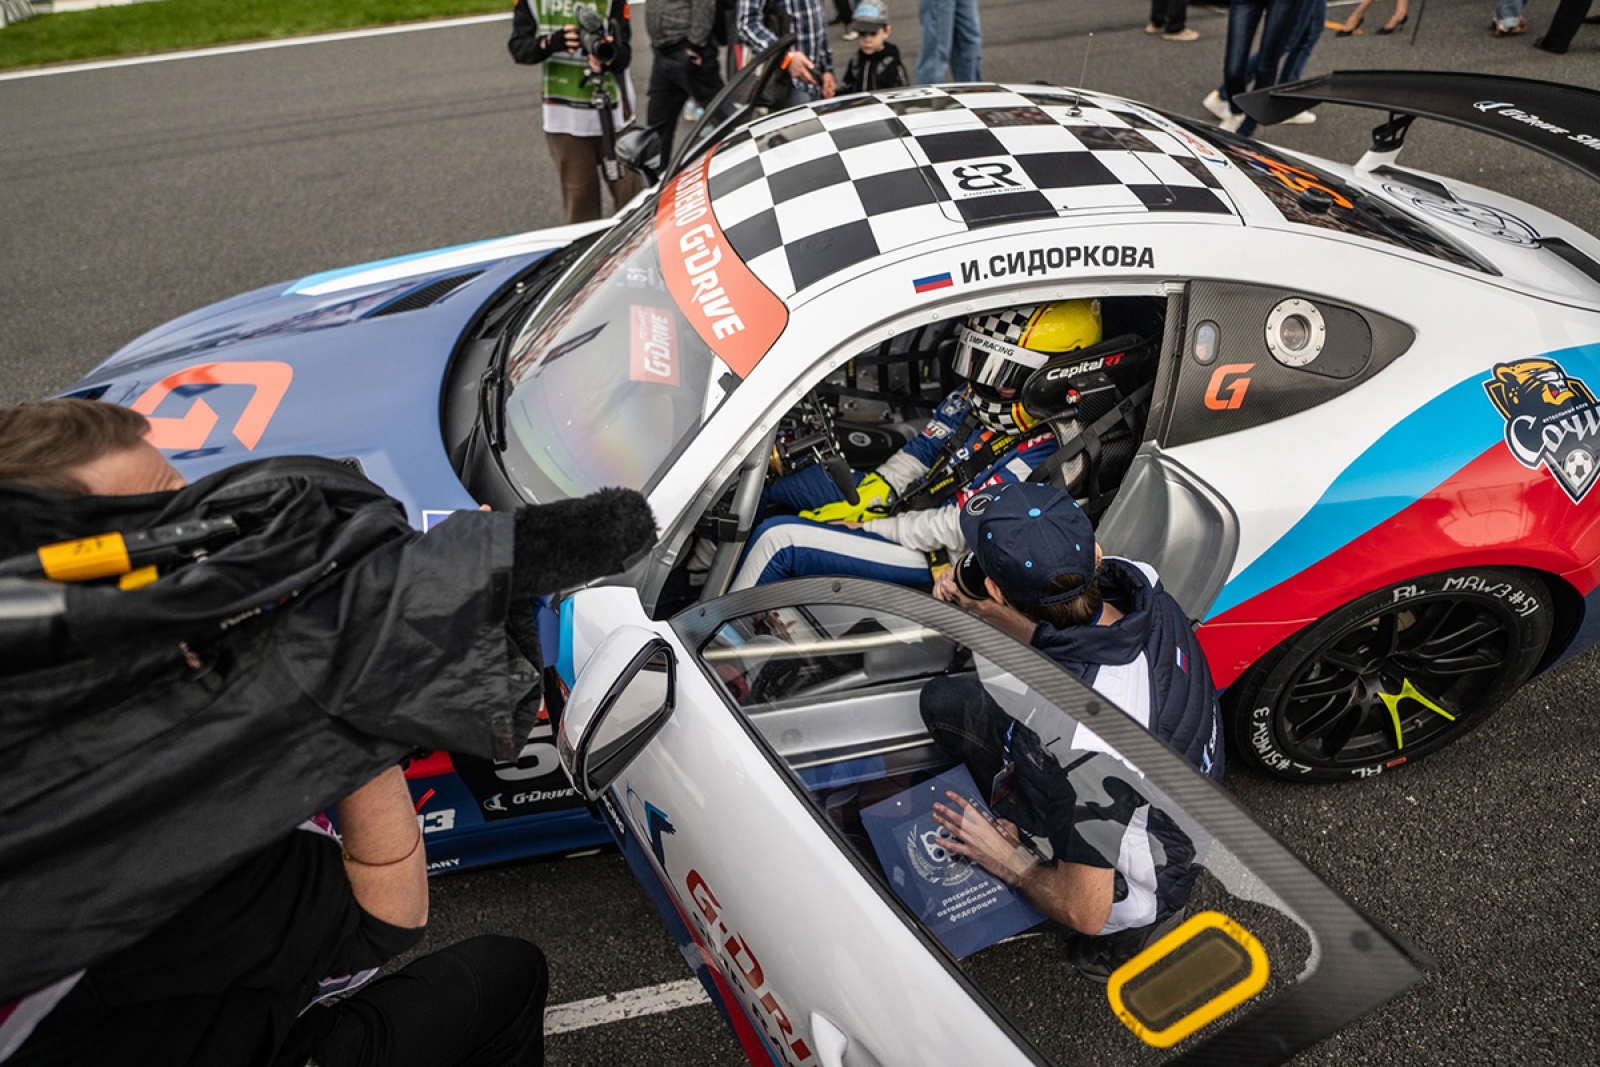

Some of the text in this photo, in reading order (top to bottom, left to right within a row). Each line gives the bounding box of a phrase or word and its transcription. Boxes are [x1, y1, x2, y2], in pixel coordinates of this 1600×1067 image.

[960, 245, 1155, 284] И.СИДОРКОВА
[982, 340, 1015, 357] RACING
[949, 896, 998, 923] федерация
